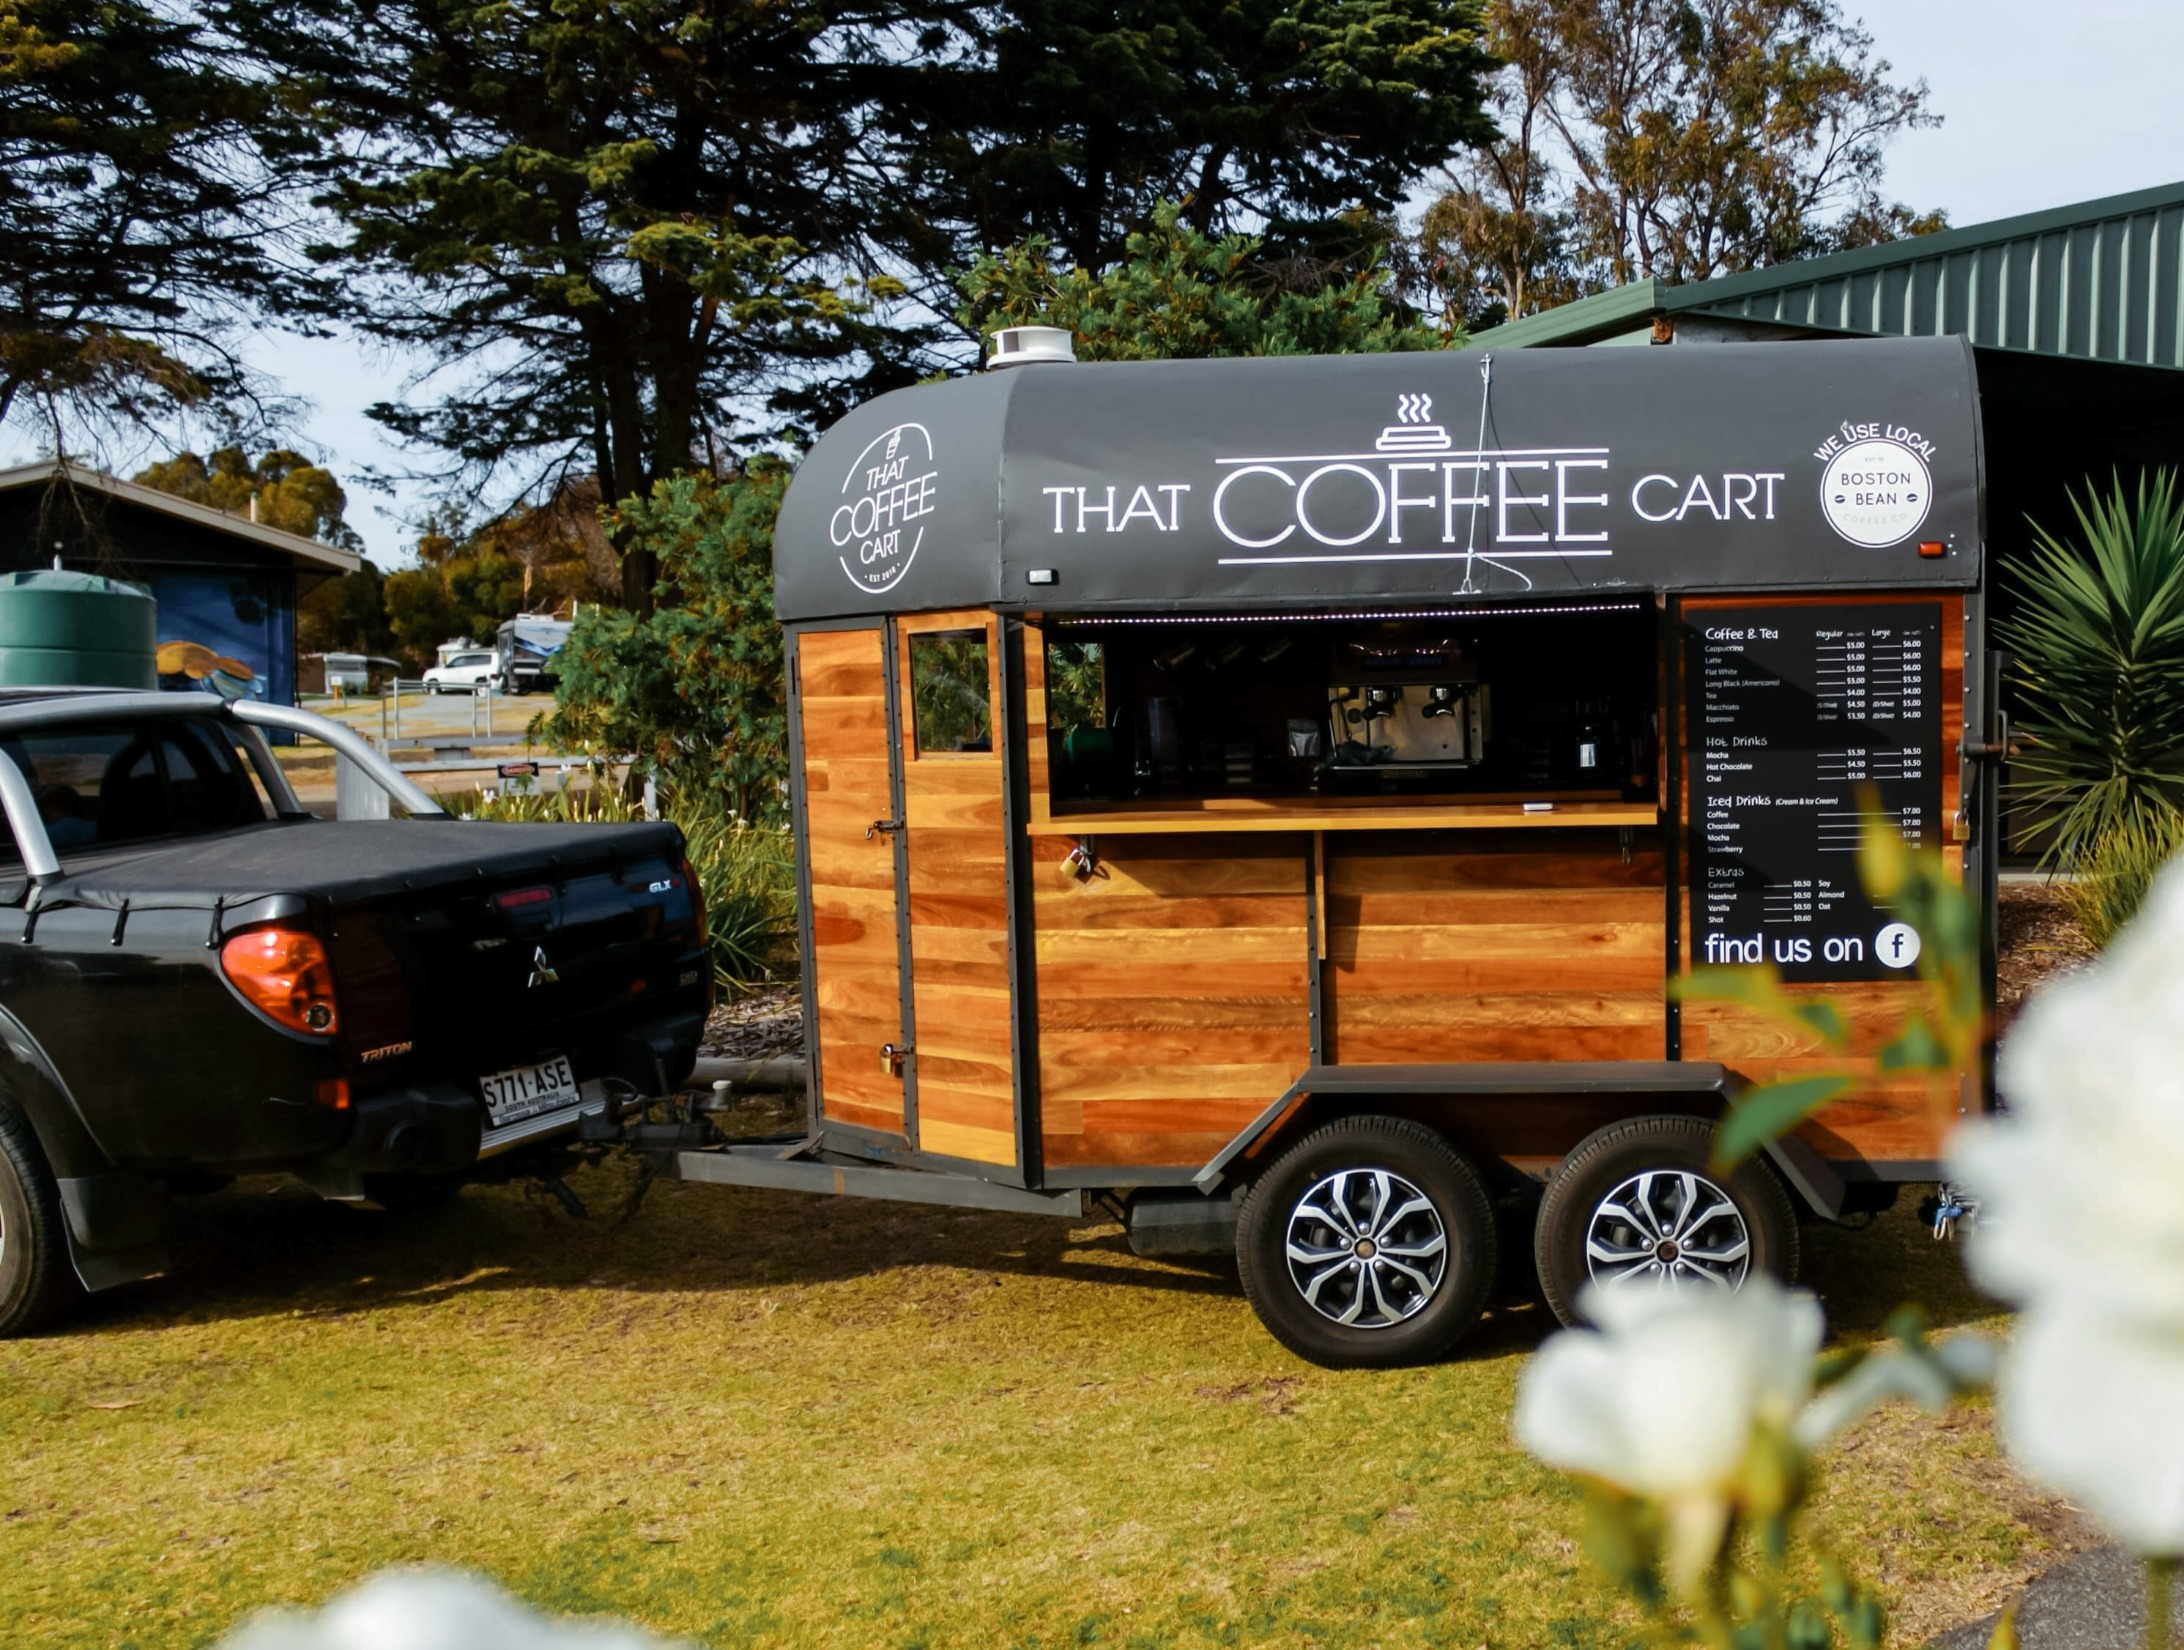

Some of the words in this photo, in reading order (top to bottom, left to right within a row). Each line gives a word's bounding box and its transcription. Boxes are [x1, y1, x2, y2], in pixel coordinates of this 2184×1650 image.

[1814, 435, 1843, 462] WE
[1843, 423, 1880, 443] USE
[1886, 424, 1936, 463] LOCAL
[866, 455, 909, 491] THAT
[1841, 472, 1911, 486] BOSTON
[1043, 485, 1191, 533] THAT
[1213, 459, 1609, 549] COFFEE
[1632, 473, 1785, 521] CART
[1855, 492, 1897, 506] BEAN
[830, 471, 938, 546] COFFEE
[860, 529, 901, 565] CART
[1705, 627, 1744, 640] Coffee
[1747, 628, 1757, 640] &
[1759, 628, 1779, 640] Tea
[1816, 630, 1843, 640] Regular
[1871, 629, 1892, 639] Large
[1704, 645, 1744, 653] Cappuccino
[1846, 641, 1865, 649] $5.00
[1902, 640, 1922, 648] $6.00
[1846, 653, 1865, 661] $5.00
[1902, 652, 1922, 660] $6.00
[1846, 665, 1865, 673] $5.00
[1902, 663, 1922, 672] $6.00
[1705, 681, 1722, 689] Long
[1846, 677, 1865, 685] $5.00
[1902, 675, 1922, 683] $5.50
[1902, 687, 1922, 695] $4.00
[1846, 700, 1866, 709] $4.50
[1902, 699, 1922, 707] $5.00
[1902, 711, 1922, 719] $4.00
[1706, 736, 1728, 747] Hot
[1733, 735, 1768, 747] Drinks
[1705, 751, 1729, 759] Mocha
[1846, 748, 1865, 757] $5.50
[1902, 747, 1922, 755] $6.50
[1719, 762, 1753, 770] Chocolate
[1846, 761, 1865, 769] $4.50
[1902, 759, 1922, 767] $5.50
[1706, 774, 1722, 783] Chai
[1846, 772, 1865, 780] $5.00
[1902, 771, 1922, 779] $6.00
[1707, 796, 1732, 808] Iced
[1736, 795, 1772, 806] Drinks
[1706, 811, 1729, 819] Coffee
[1902, 807, 1921, 815] $7.00
[1902, 819, 1921, 827] $7.00
[1707, 845, 1744, 853] Strawberry
[1707, 867, 1745, 877] Extras
[1708, 881, 1735, 889] Caramel
[1793, 880, 1812, 888] $0.50
[1818, 879, 1831, 888] Soy
[1707, 893, 1738, 901] Hazelnut
[1793, 892, 1812, 900] $0.50
[1818, 891, 1845, 899] Almond
[1707, 905, 1730, 913] Vanilla
[1793, 903, 1812, 911] $0.50
[1708, 916, 1725, 924] Shot
[1793, 915, 1812, 923] $0.60
[1704, 933, 1763, 964] find
[1774, 938, 1813, 963] us
[1823, 937, 1863, 962] on
[361, 1041, 412, 1063] TRITON
